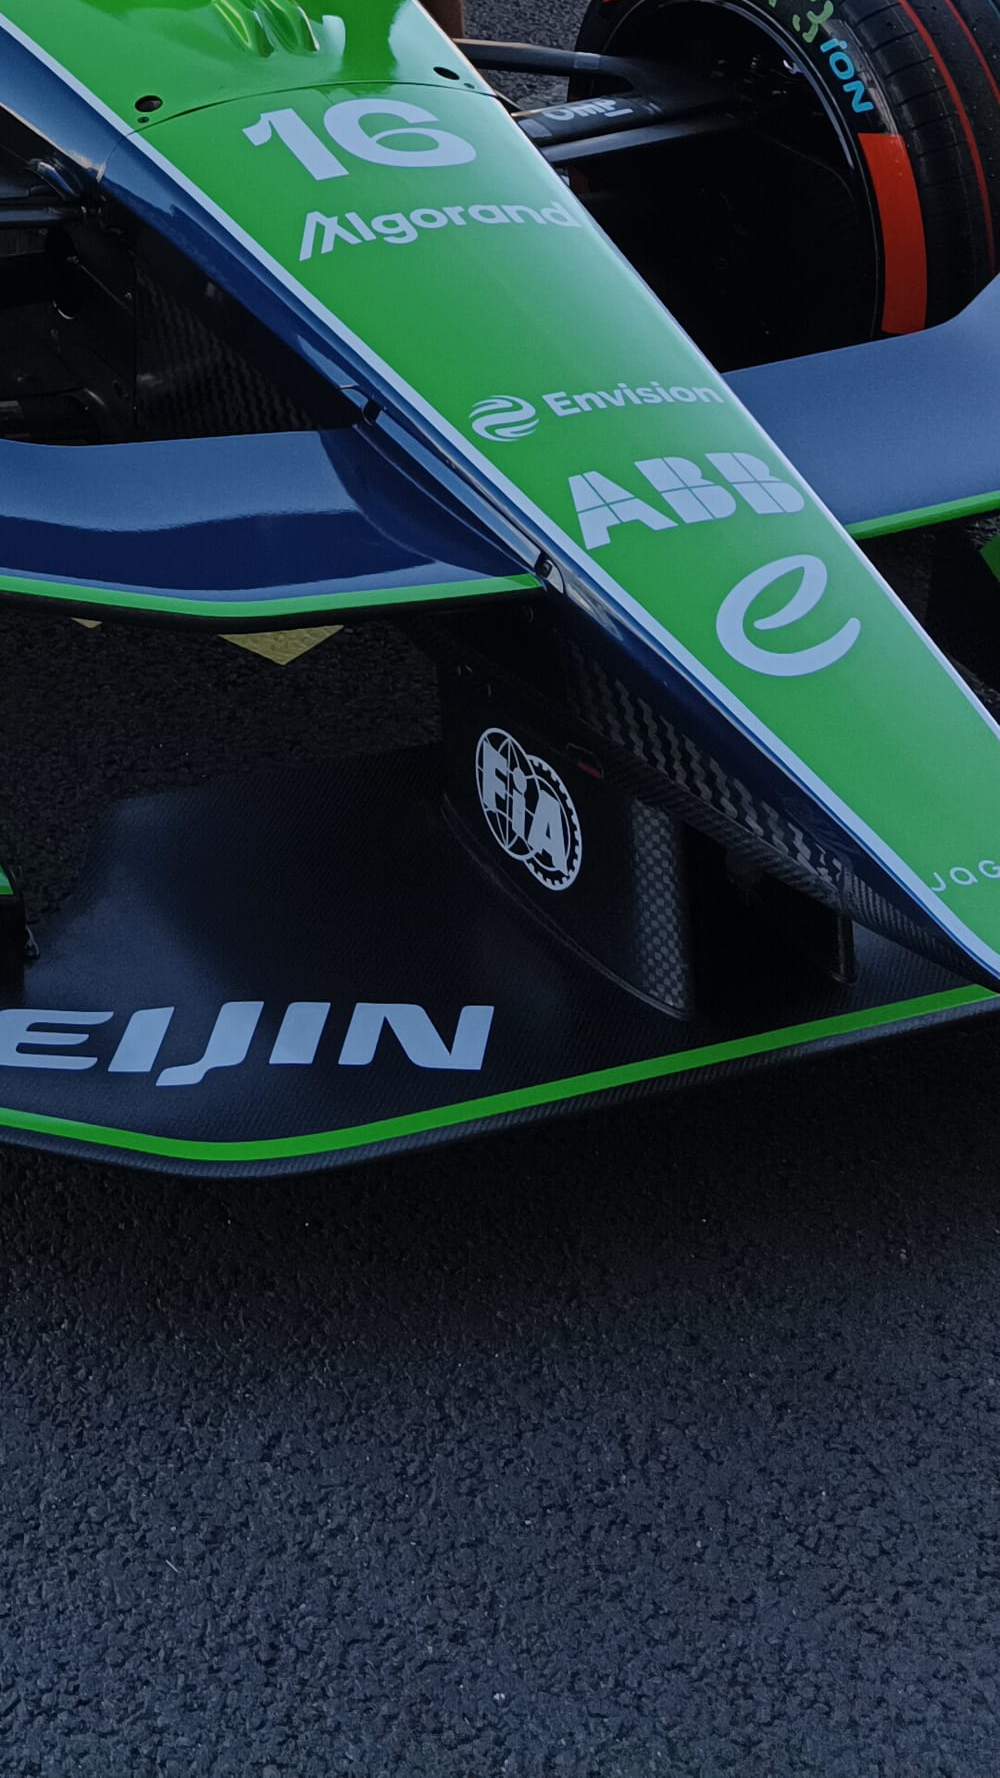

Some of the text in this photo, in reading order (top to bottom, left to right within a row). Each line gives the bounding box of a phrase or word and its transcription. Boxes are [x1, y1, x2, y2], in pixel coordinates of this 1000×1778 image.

[242, 98, 477, 182] 16
[299, 199, 585, 262] Algorand
[543, 381, 725, 418] Envision
[567, 452, 806, 550] ABB
[479, 734, 572, 879] FIA
